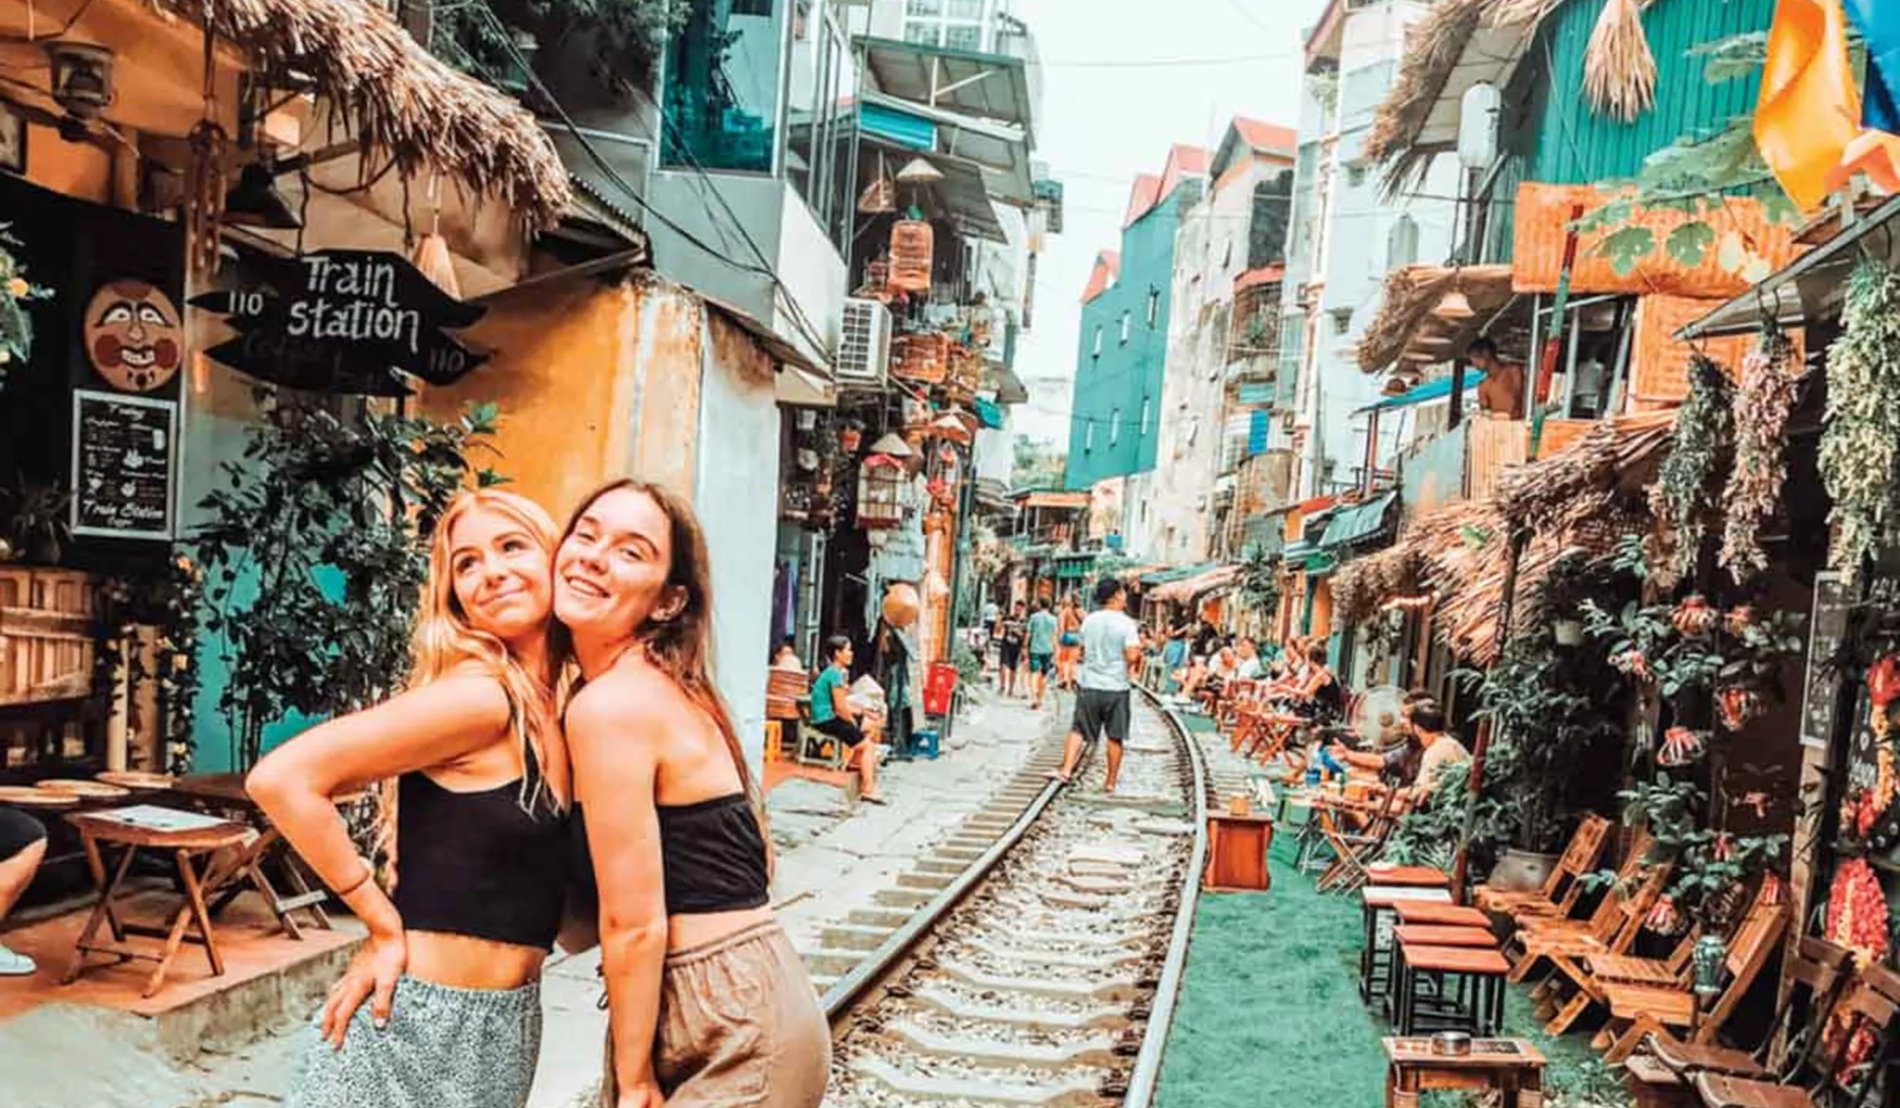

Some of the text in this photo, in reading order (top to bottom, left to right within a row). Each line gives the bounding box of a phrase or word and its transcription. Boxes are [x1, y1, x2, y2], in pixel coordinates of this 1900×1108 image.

[302, 256, 399, 307] Train
[228, 290, 264, 316] 110
[429, 349, 466, 372] 110
[82, 499, 117, 516] Train
